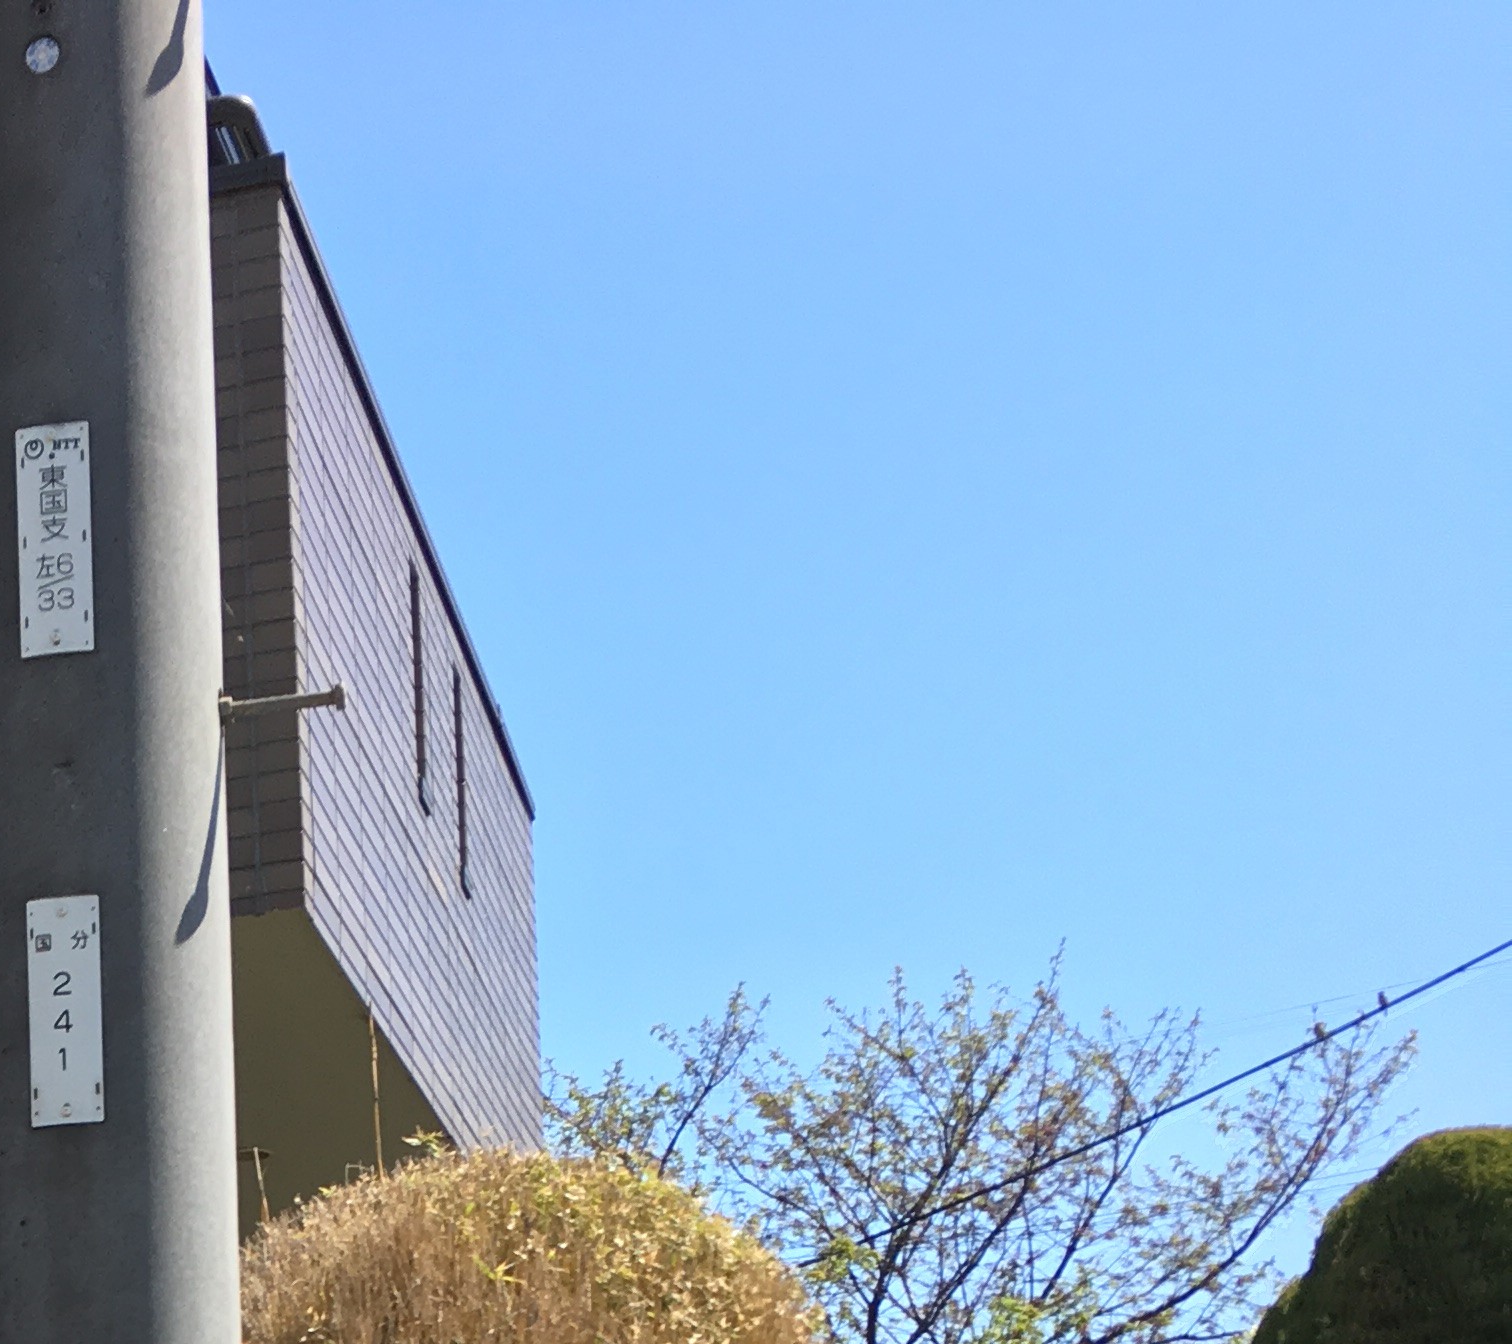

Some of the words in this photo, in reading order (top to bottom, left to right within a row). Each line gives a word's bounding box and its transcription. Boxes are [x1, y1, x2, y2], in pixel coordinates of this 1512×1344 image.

[52, 437, 81, 451] NTT
[39, 463, 69, 544] 東国支
[36, 552, 74, 580] 左6
[38, 588, 75, 612] 33
